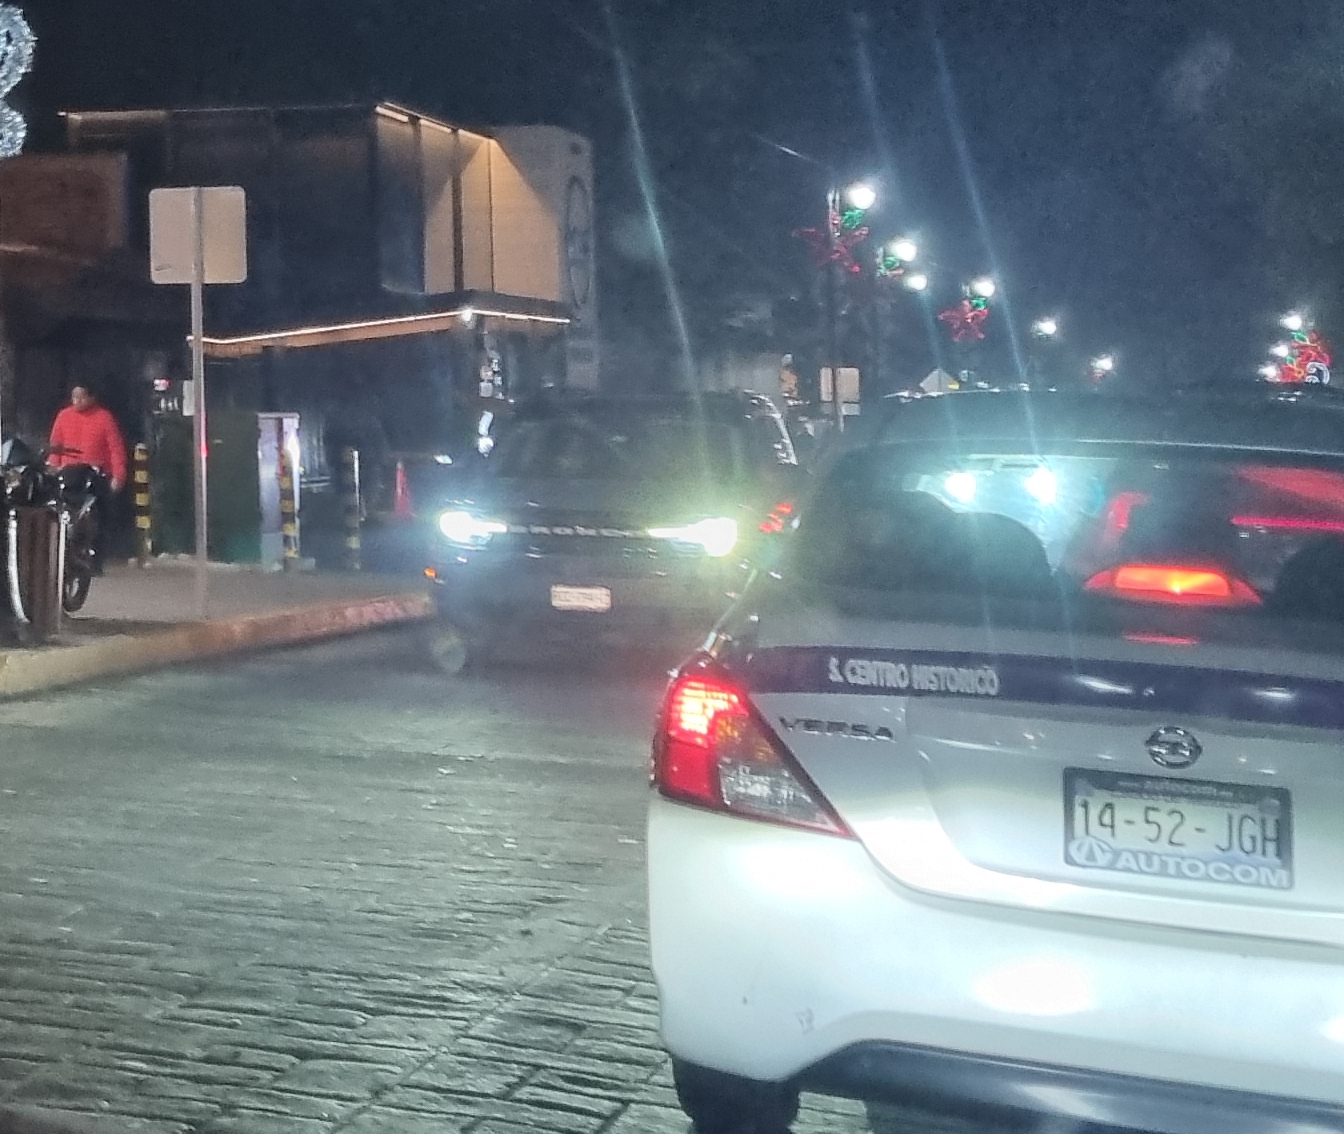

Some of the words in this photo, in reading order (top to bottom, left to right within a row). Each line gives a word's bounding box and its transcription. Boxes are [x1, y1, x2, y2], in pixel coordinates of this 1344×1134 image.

[844, 659, 909, 689] CENTRO
[779, 716, 896, 741] VERSA
[1076, 798, 1281, 858] 14-52-JGH
[1115, 850, 1292, 890] AUTOCOM
